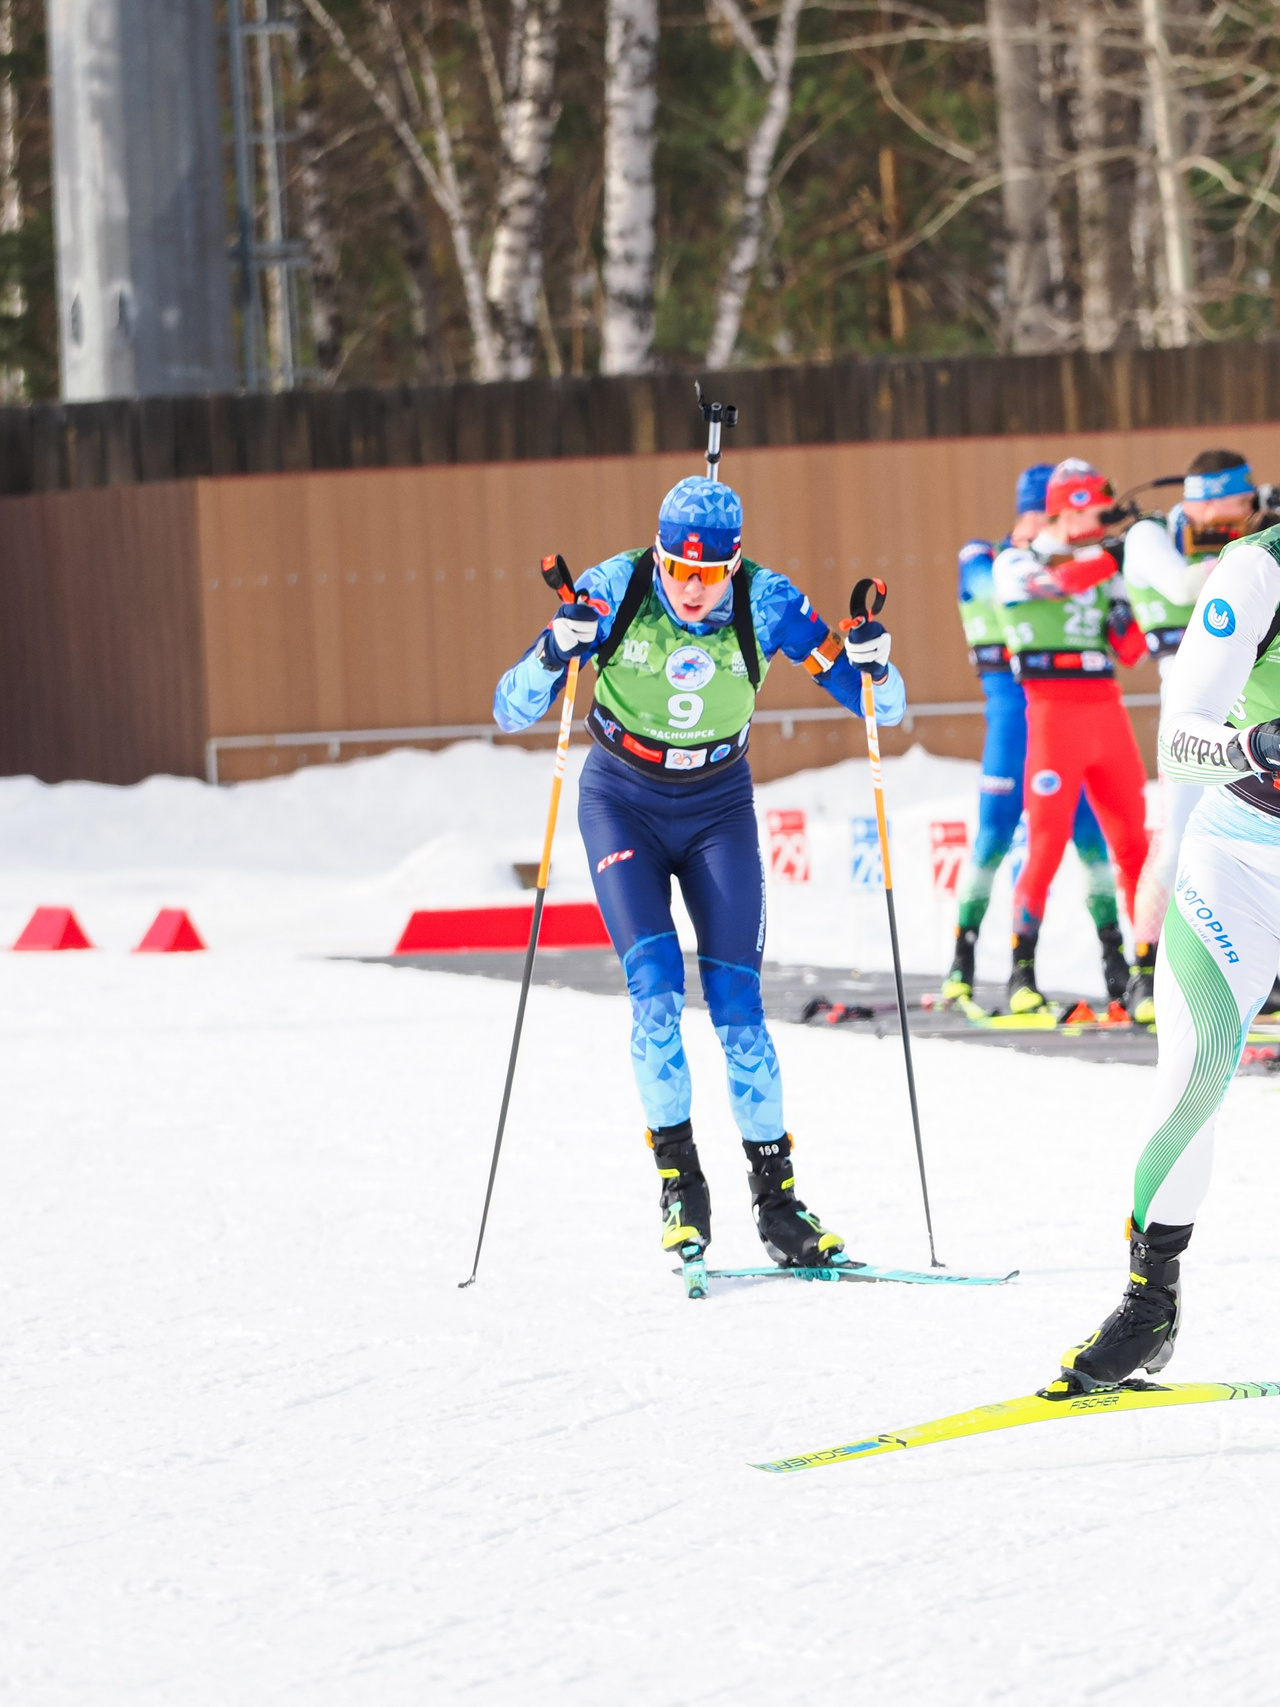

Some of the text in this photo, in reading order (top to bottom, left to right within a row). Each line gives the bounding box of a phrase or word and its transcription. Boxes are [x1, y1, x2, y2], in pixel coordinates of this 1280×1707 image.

[667, 692, 704, 730] 9
[1184, 886, 1240, 964] ЮГОРИЯ
[1069, 1396, 1120, 1411] FISCHER
[776, 1446, 852, 1471] SCHER
